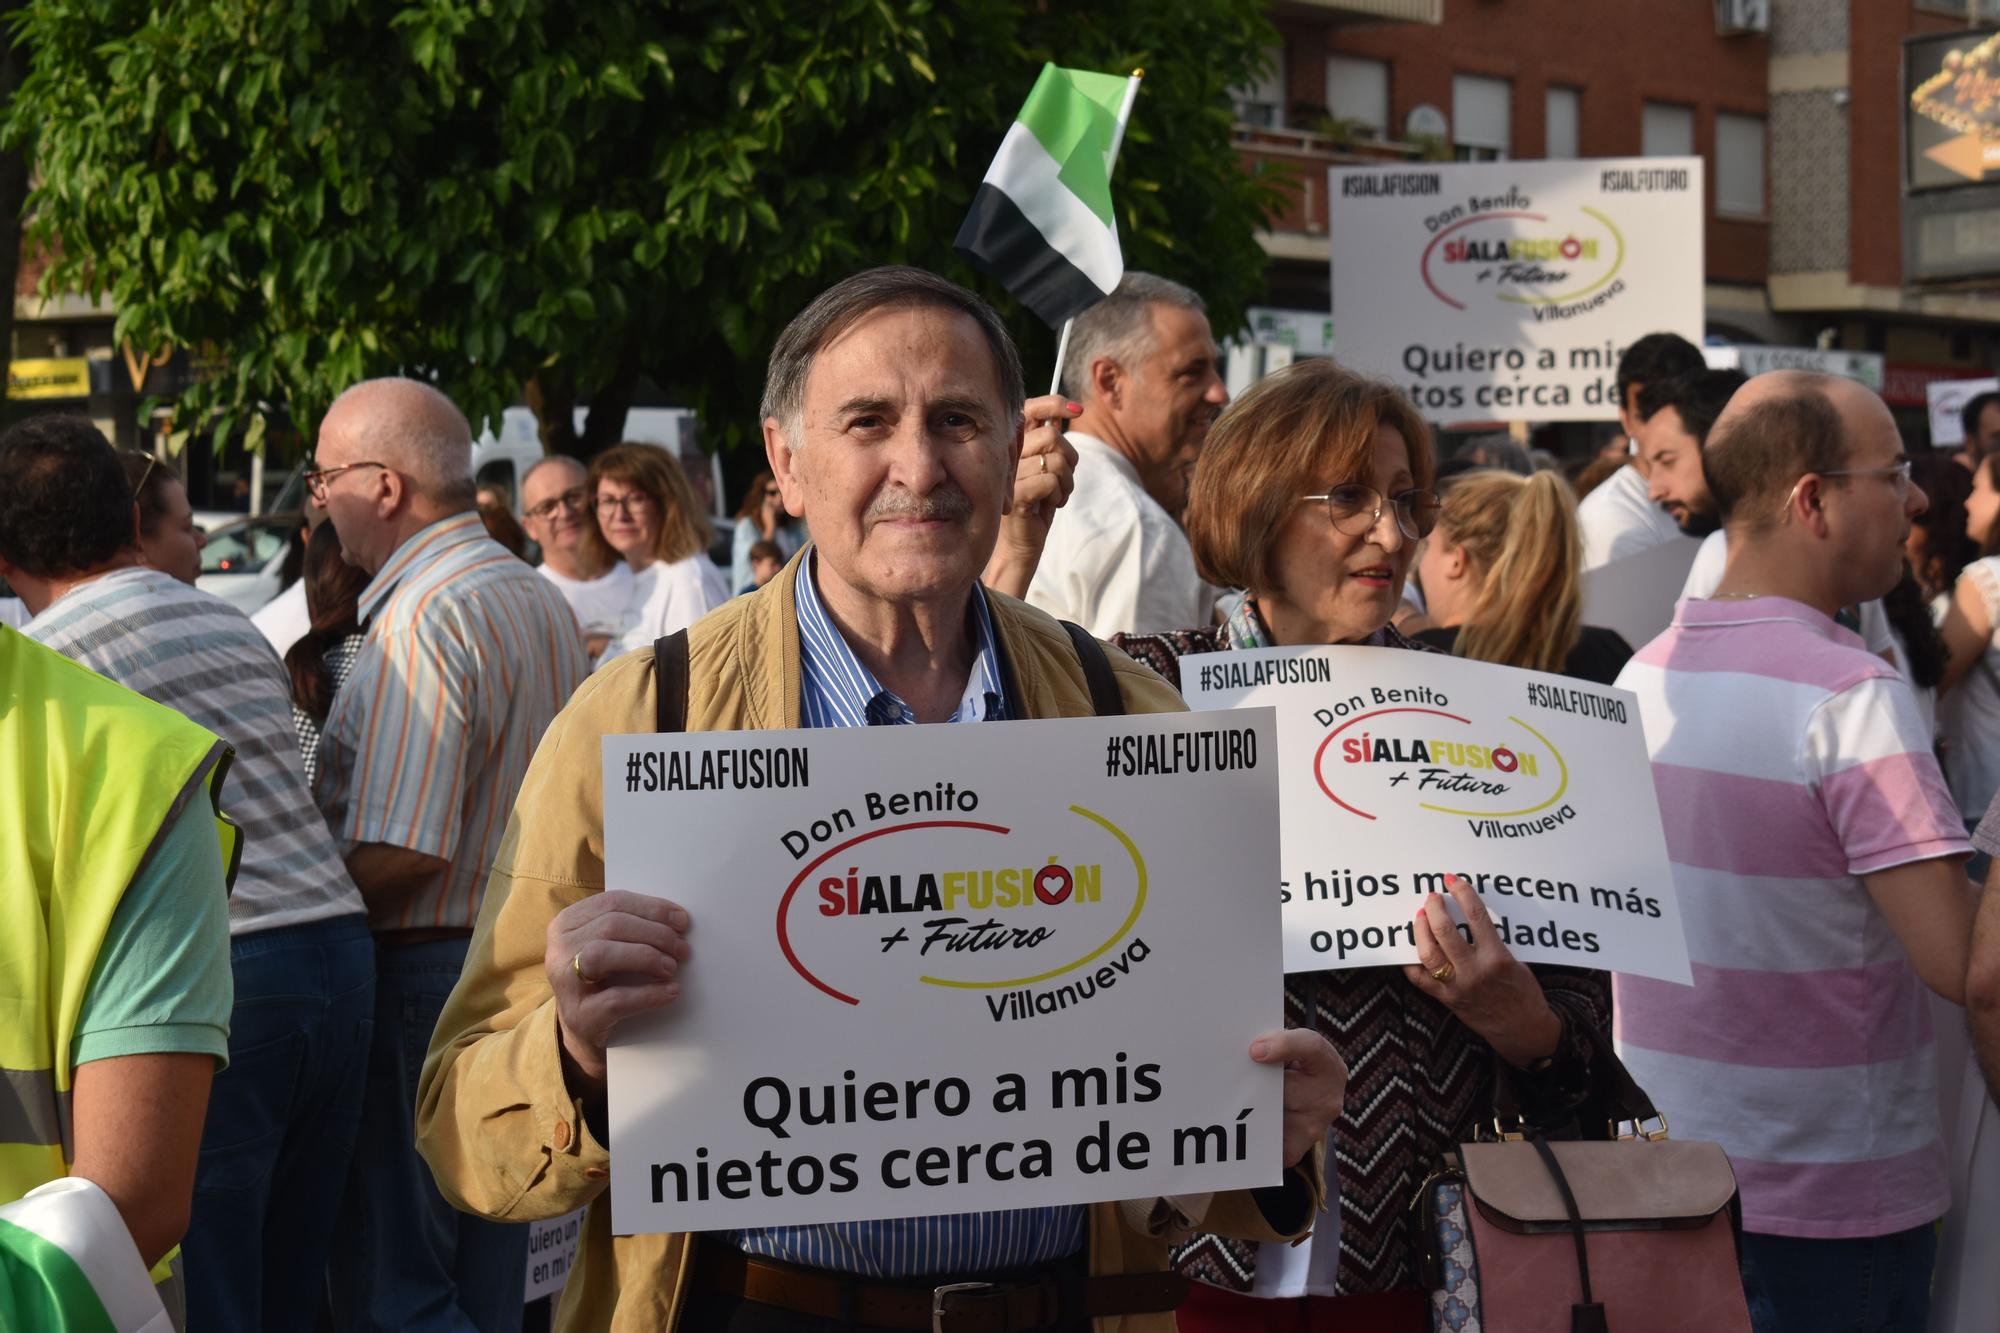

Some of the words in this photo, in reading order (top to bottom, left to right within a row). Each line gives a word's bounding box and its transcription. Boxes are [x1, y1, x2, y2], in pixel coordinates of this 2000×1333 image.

[1342, 173, 1440, 197] #SIALAFUSION
[1600, 168, 1688, 192] #SIALFUTURO
[1424, 206, 1465, 233] Don
[1469, 186, 1531, 212] Benito
[1497, 263, 1570, 285] Futuro
[1533, 278, 1625, 323] Villanueva
[1402, 342, 1525, 375] Quiero
[1536, 349, 1556, 371] a
[1475, 383, 1571, 408] cerca
[1200, 657, 1331, 691] #SIALAFUSION
[1313, 696, 1365, 728] Don
[1371, 686, 1449, 708] Benito
[1527, 682, 1628, 725] #SIALFUTURO
[626, 748, 809, 793] #SIALAFUSION
[1106, 728, 1257, 777] #SIALFUTURO
[1418, 768, 1512, 797] Futuro
[780, 808, 856, 862] Don
[865, 782, 979, 818] Benito
[1468, 803, 1576, 839] Villanueva
[1304, 869, 1400, 907] hijos
[1591, 887, 1662, 919] más
[920, 917, 1055, 957] Futuro
[1310, 915, 1601, 960] oportndades
[985, 935, 1152, 1023] Villanueva
[743, 1070, 971, 1138] Quiero
[993, 1073, 1027, 1114] a
[1052, 1052, 1162, 1108] mis
[651, 1147, 859, 1204] nietos
[881, 1140, 1053, 1190] cerca
[1076, 1120, 1151, 1175] de
[1174, 1108, 1255, 1167] mí
[530, 1226, 563, 1254] uiero
[565, 1220, 578, 1241] un
[533, 1263, 550, 1285] en
[552, 1249, 566, 1279] mi
